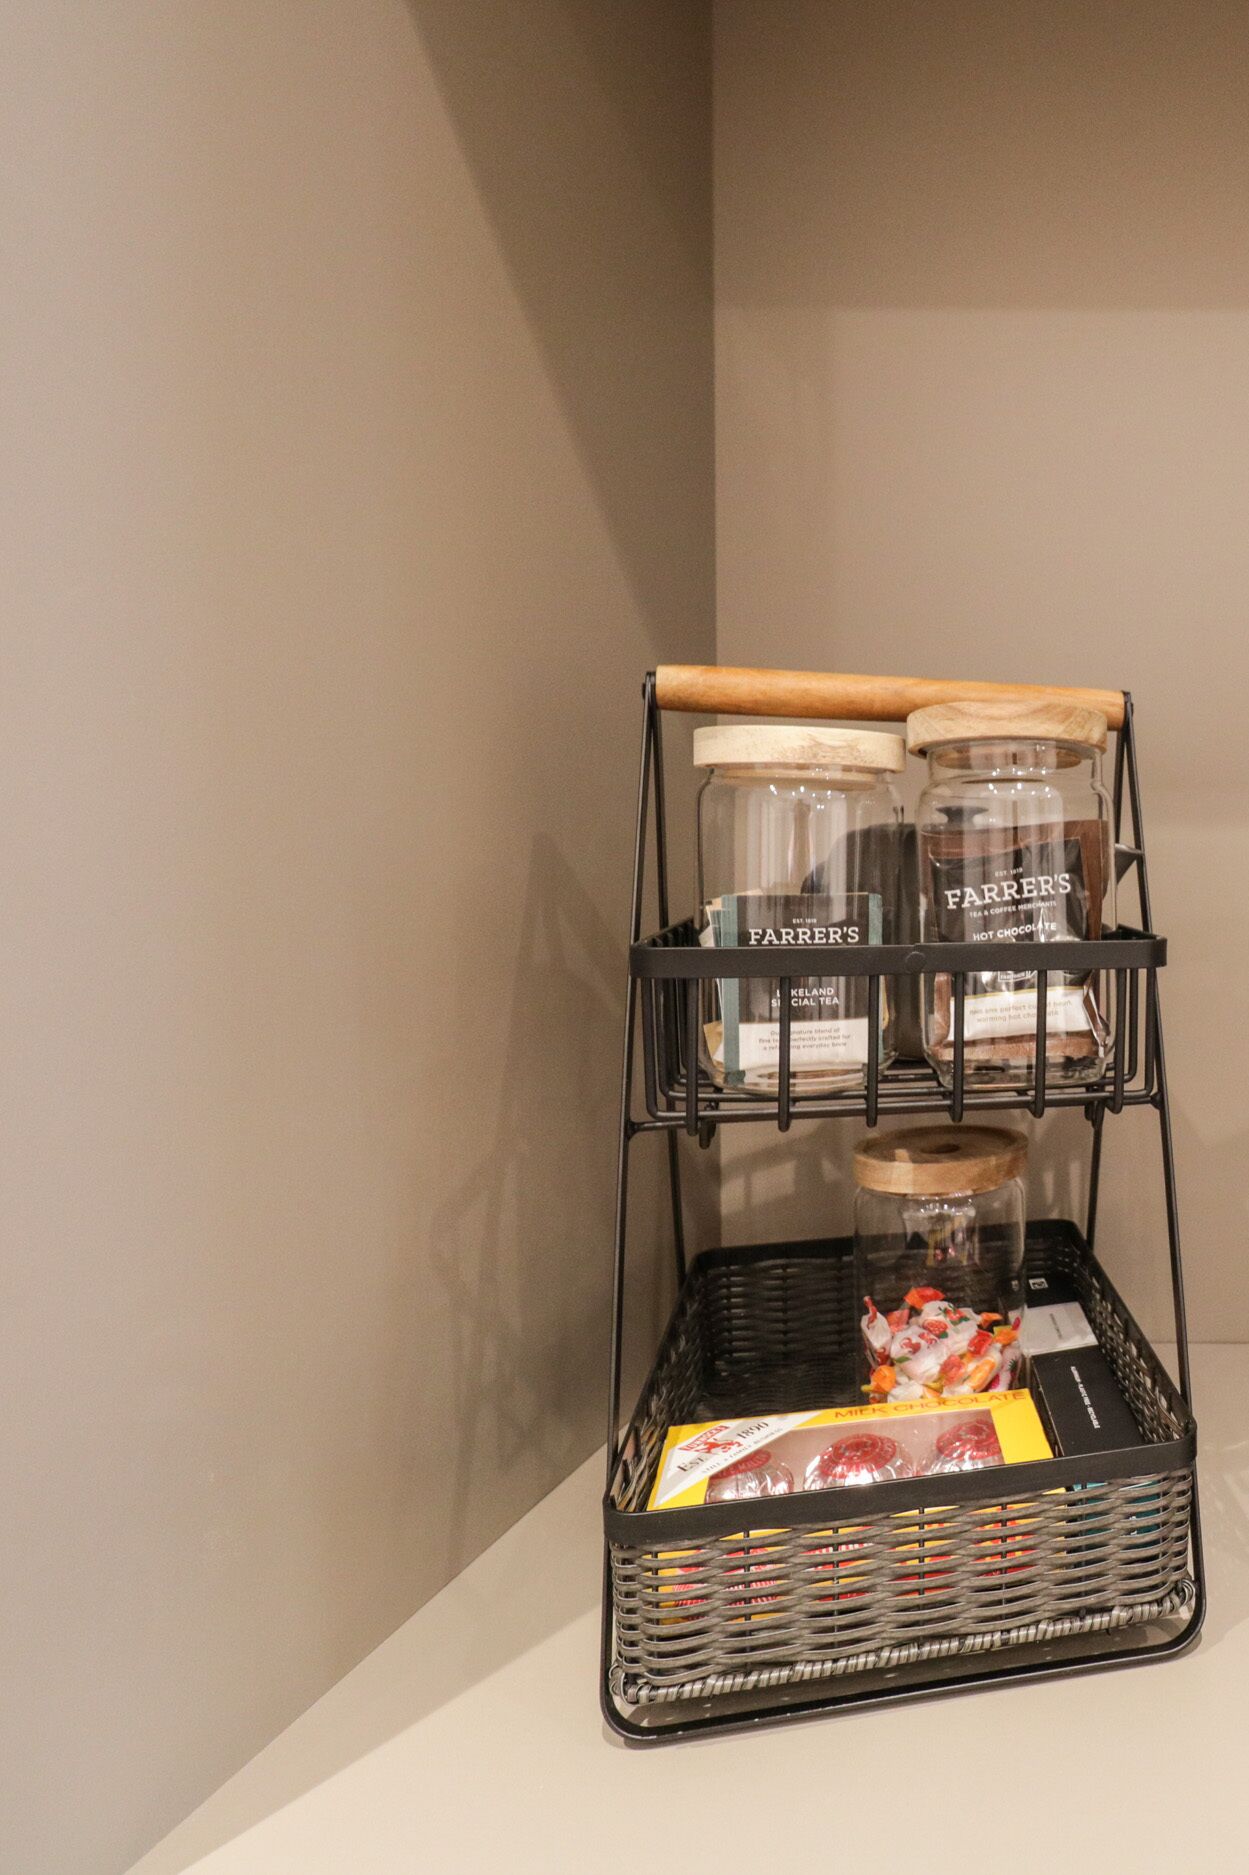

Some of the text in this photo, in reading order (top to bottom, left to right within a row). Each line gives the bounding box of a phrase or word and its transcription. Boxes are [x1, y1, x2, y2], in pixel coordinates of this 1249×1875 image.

[944, 873, 1072, 910] FARRER'S
[969, 910, 983, 919] TEA
[990, 905, 1017, 915] COFFEE
[1018, 900, 1057, 911] MERCHANTS
[748, 926, 860, 945] FARRER'S
[973, 921, 1057, 942] HOT CHOCOLATE
[771, 996, 840, 1008] SCIAL TEA
[776, 987, 835, 998] LKELAND
[834, 1391, 1027, 1419] MILK CHOCOLATE
[736, 1421, 770, 1440] 1890
